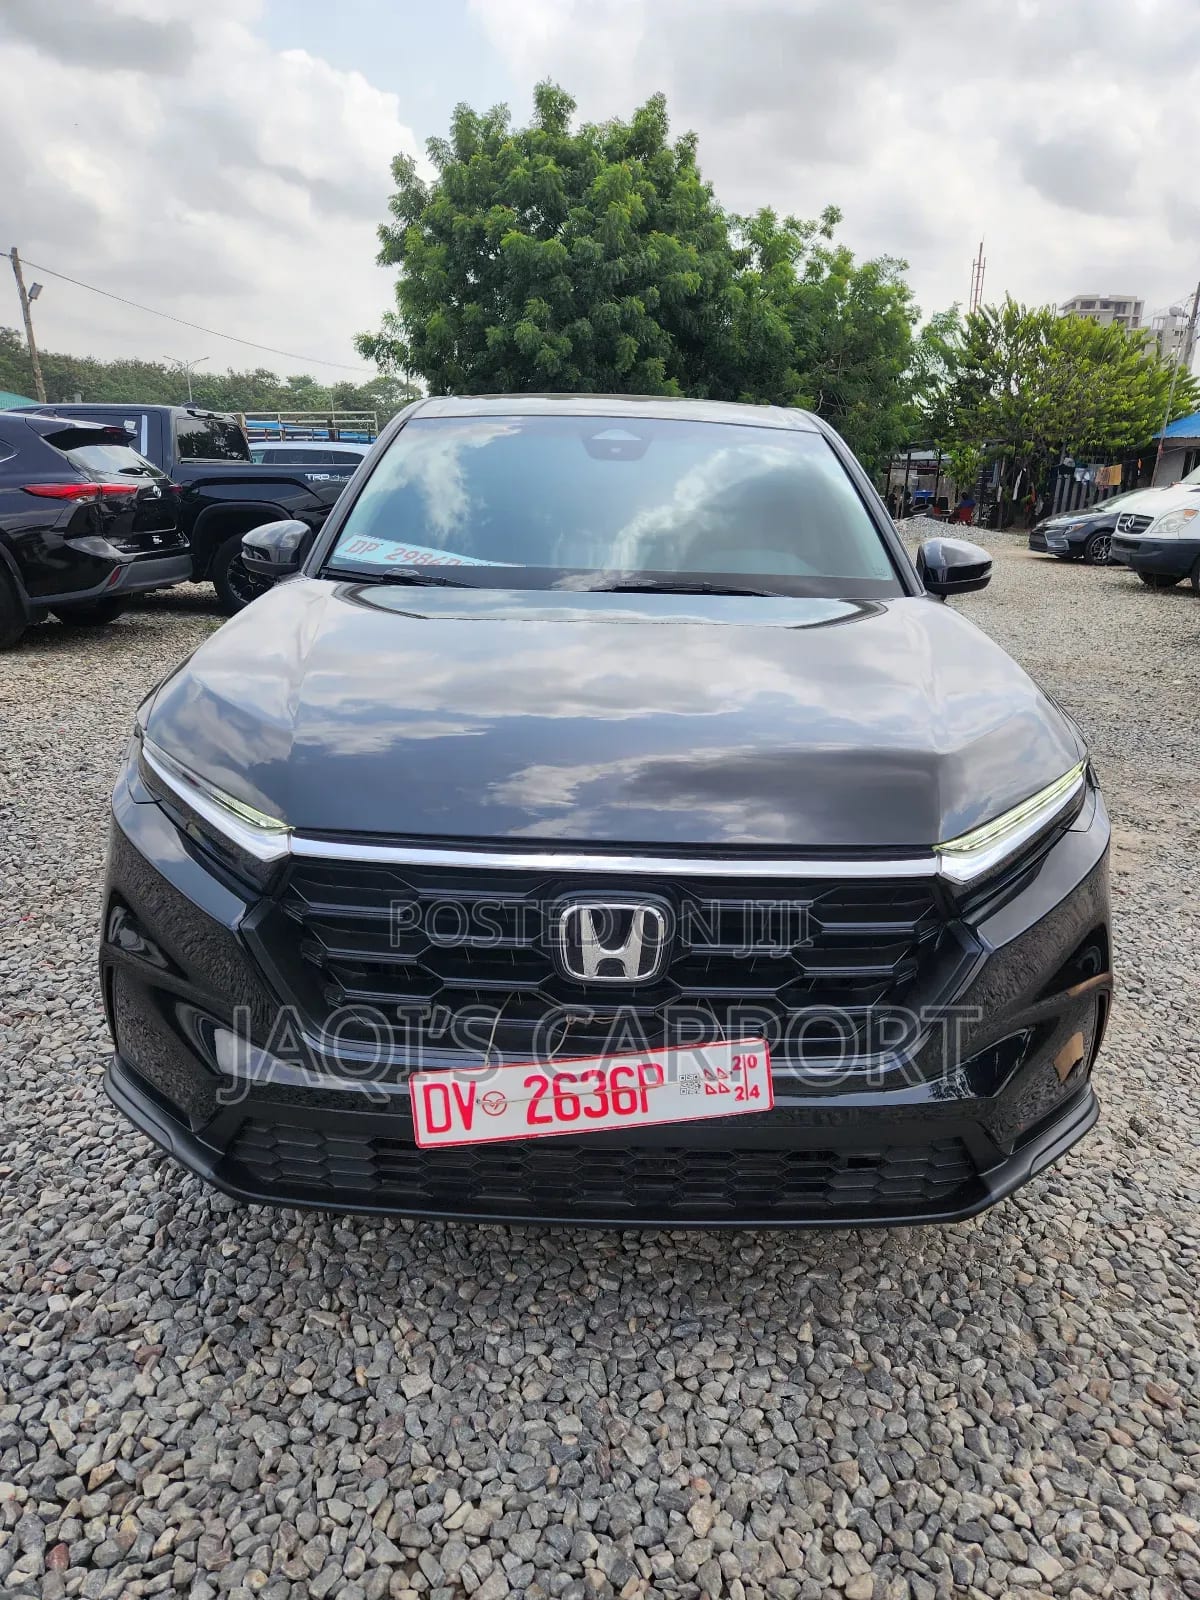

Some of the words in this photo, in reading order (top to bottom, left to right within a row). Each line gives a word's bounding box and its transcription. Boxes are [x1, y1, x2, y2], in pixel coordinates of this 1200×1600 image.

[305, 473, 330, 481] TRD
[422, 1080, 477, 1134] DV
[523, 1063, 665, 1126] 2636P
